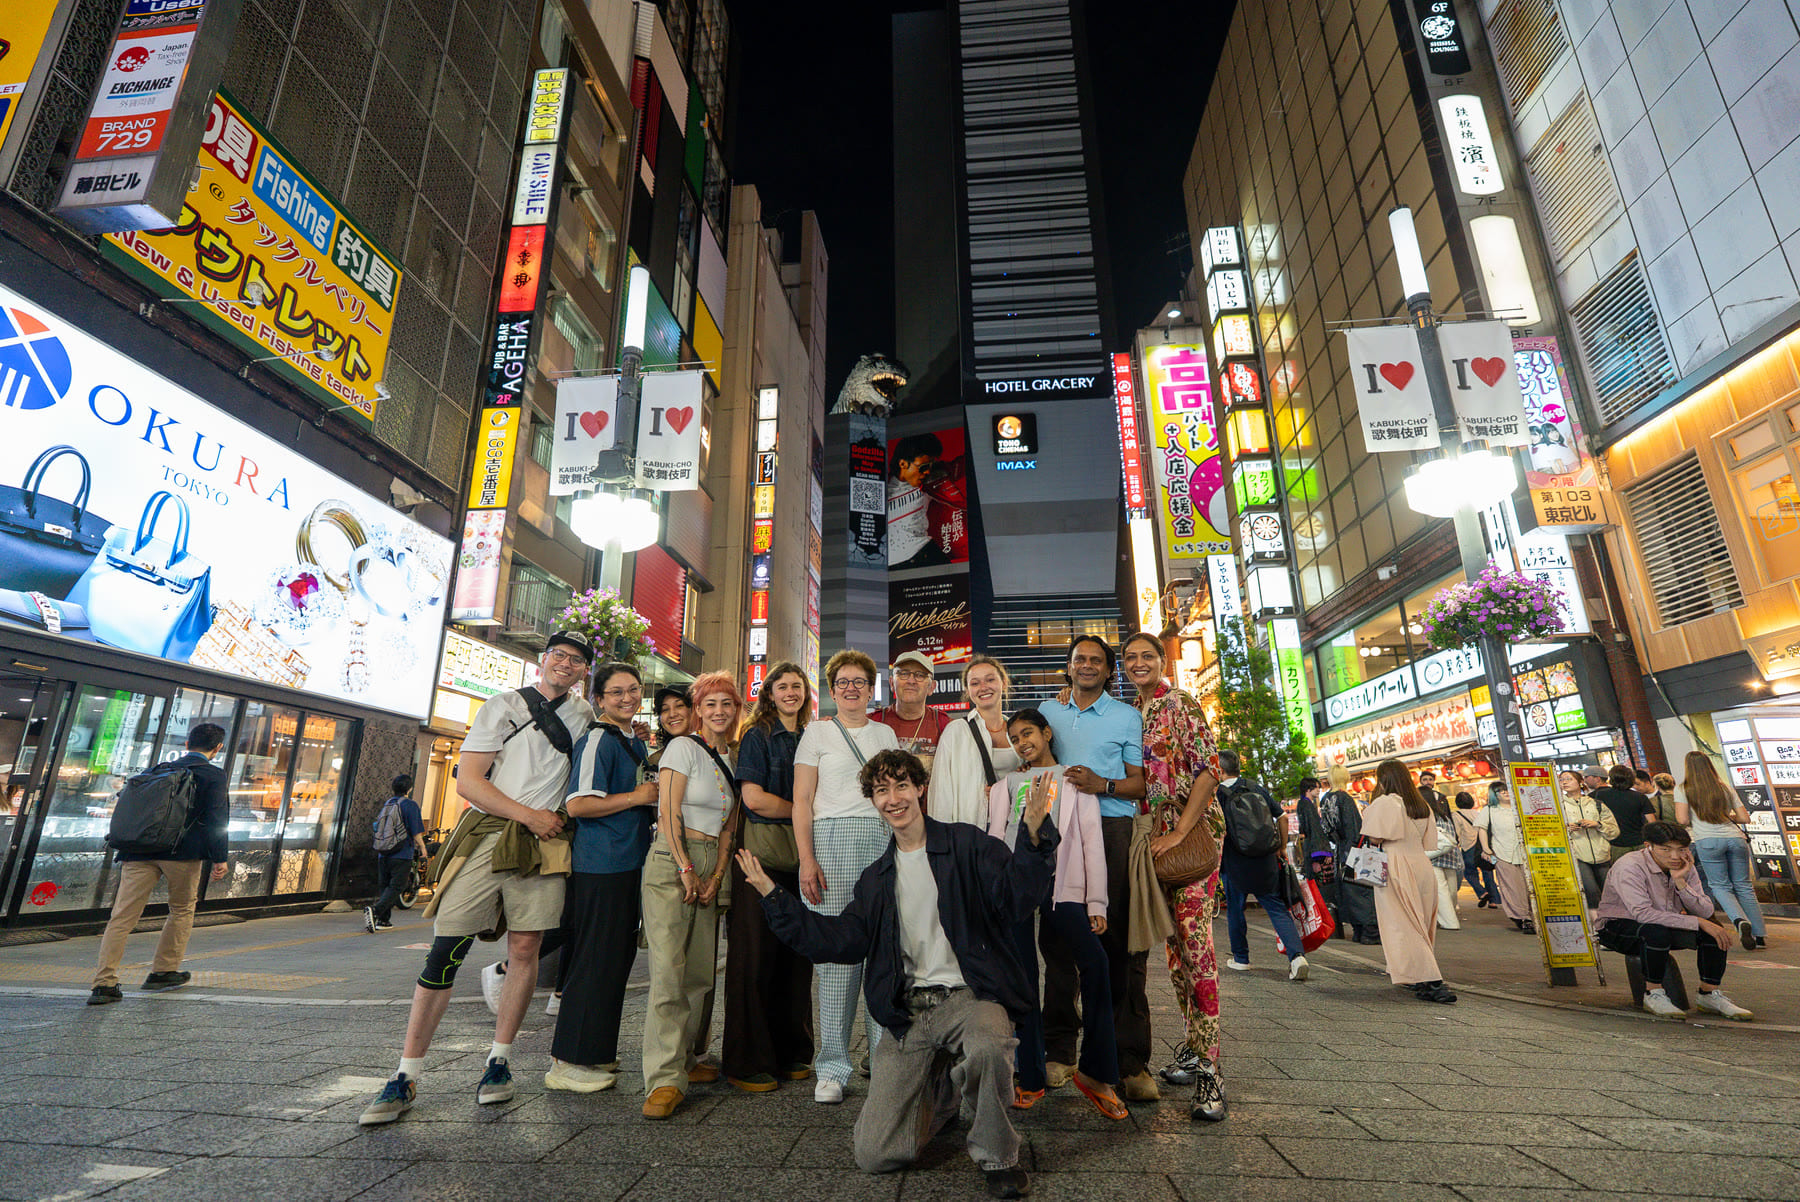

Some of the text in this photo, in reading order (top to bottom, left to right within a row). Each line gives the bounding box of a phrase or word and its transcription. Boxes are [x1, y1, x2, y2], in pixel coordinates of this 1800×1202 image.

[1432, 2, 1448, 13] 6F
[110, 77, 176, 94] EXCHANGE
[102, 118, 156, 133] BRAND
[1455, 106, 1476, 140] 鉄板焼
[99, 130, 154, 151] 729
[73, 172, 141, 194] 藤田ビル
[257, 154, 332, 250] Fishing
[225, 197, 383, 337] タックルベリー
[337, 225, 393, 310] 釣具
[112, 231, 373, 415] New & Used Fishing tackle
[498, 323, 510, 341] BAR
[493, 351, 506, 369] PUB
[502, 319, 530, 393] AGEHA
[1362, 363, 1383, 394] I
[1452, 358, 1472, 390] I
[1532, 351, 1558, 394] ハンド
[985, 376, 1095, 393] HOTEL GRACERY
[496, 394, 512, 405] 2F
[564, 412, 579, 441] I
[650, 407, 665, 436] I
[1185, 411, 1201, 449] バイト
[1369, 417, 1428, 428] KABUKI-CHO
[997, 439, 1021, 447] TOHO
[1371, 427, 1429, 441] 歌舞伎町
[88, 384, 292, 511] OKURA
[997, 445, 1029, 454] CINEMAS
[558, 465, 596, 473] KABUKI-C
[642, 460, 693, 468] KABUKI-CHO
[996, 461, 1036, 471] IMAX
[558, 473, 595, 485] 歌舞伎
[642, 468, 692, 481] 歌舞伎町
[162, 464, 230, 507] TOKYO
[1545, 505, 1597, 523] 東京ビル
[755, 526, 771, 549] 麻雀
[1173, 541, 1231, 552] いちごなび
[1522, 555, 1567, 567] ルノアール
[1216, 559, 1234, 611] しゃぶしゃぶ
[888, 600, 968, 636] Michael
[917, 636, 936, 647] 6.12
